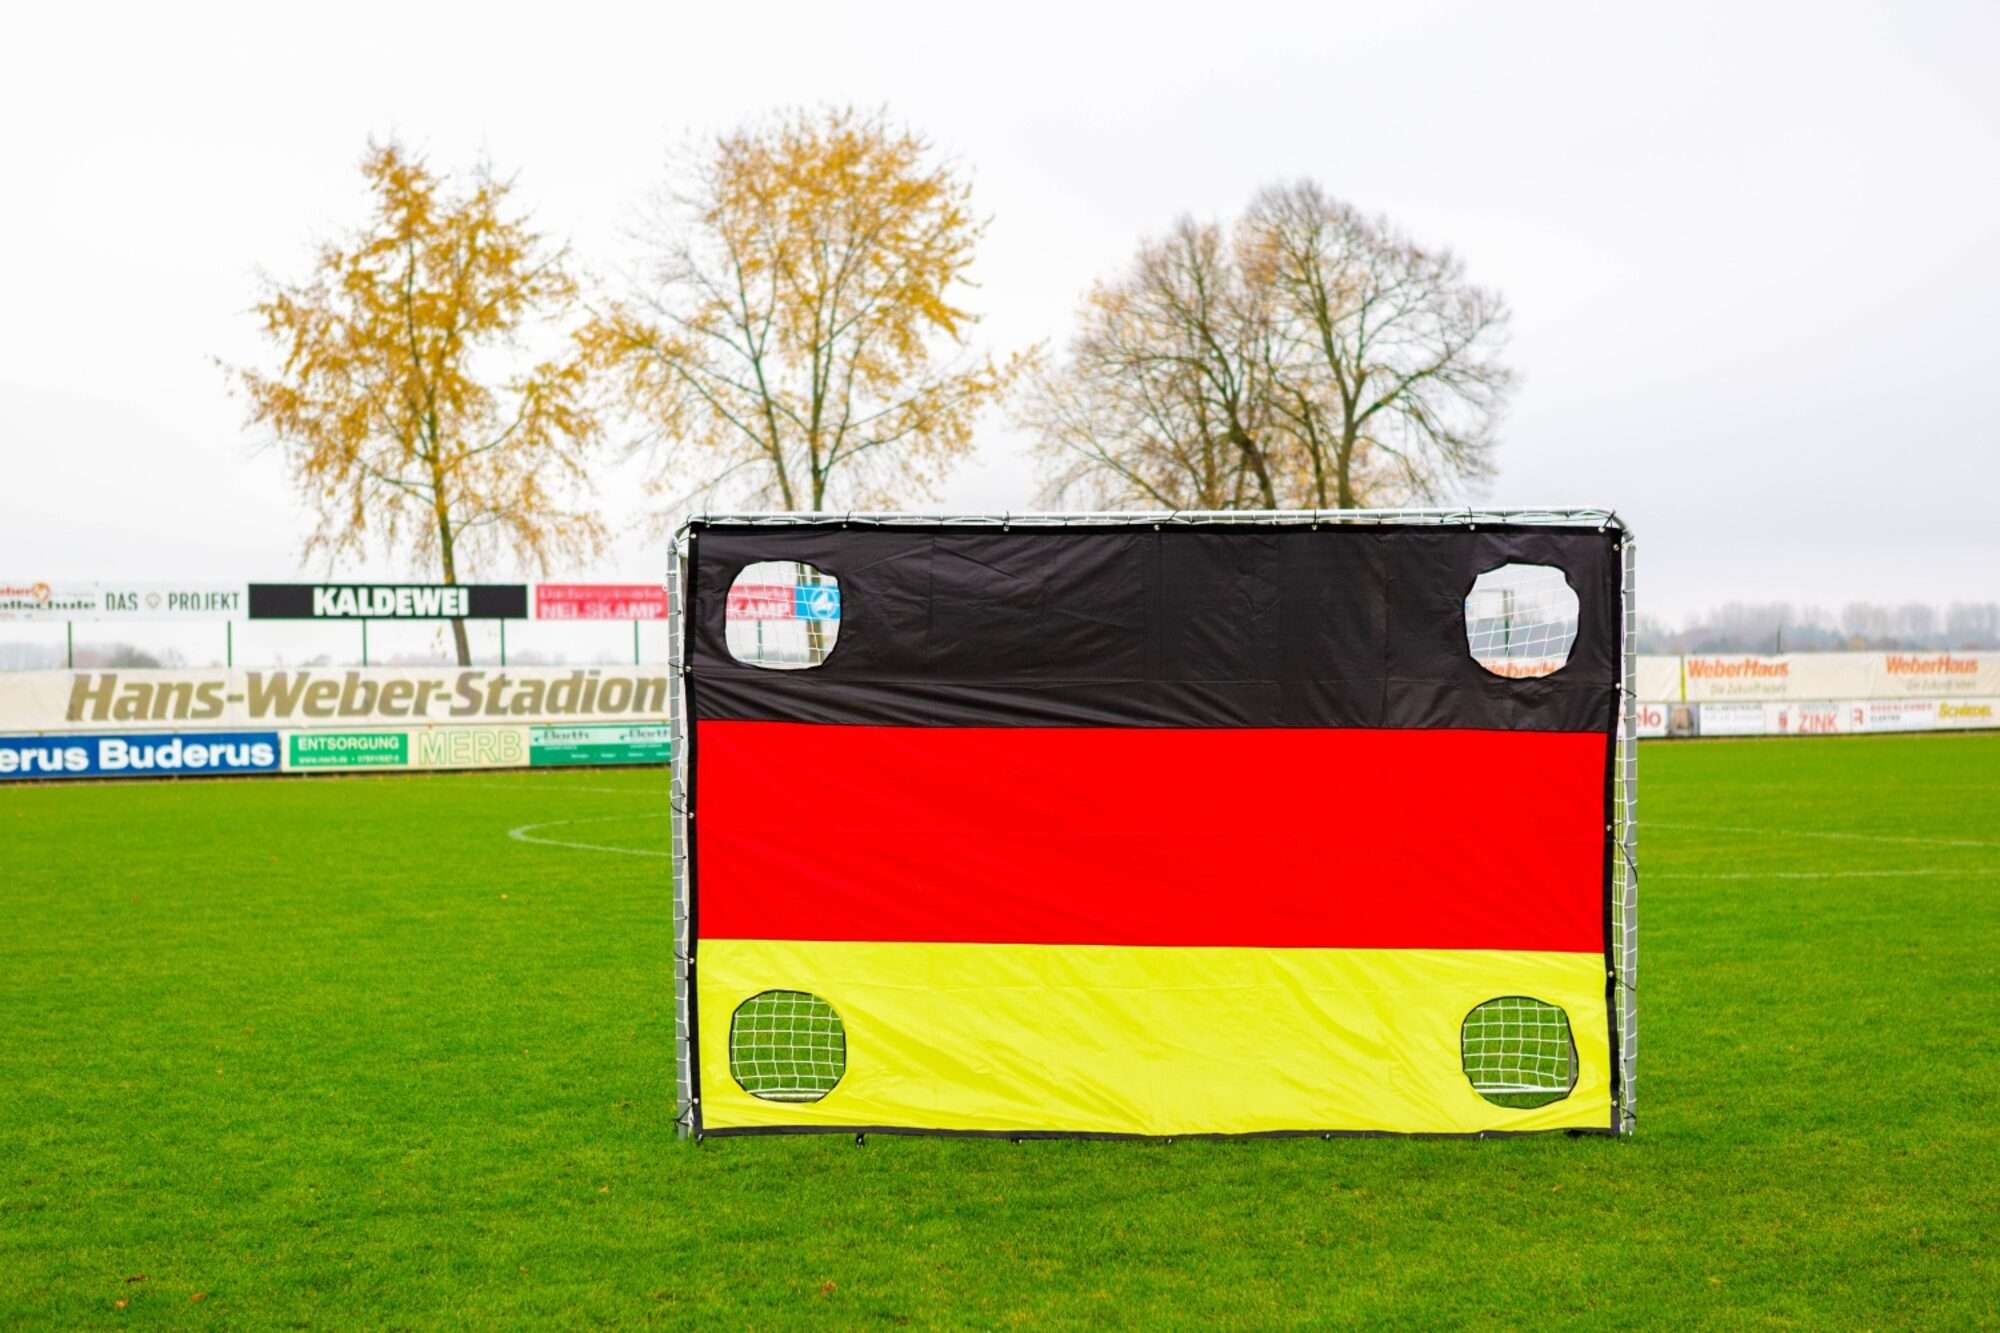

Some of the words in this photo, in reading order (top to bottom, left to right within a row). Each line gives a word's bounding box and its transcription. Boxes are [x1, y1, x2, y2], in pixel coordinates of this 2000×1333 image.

[105, 592, 139, 611] DAS
[168, 592, 240, 611] PROJEKT
[313, 587, 469, 616] KALDEWEI
[541, 602, 663, 619] NELSKAMP
[1687, 658, 1790, 679] WeberHaus
[1886, 655, 1979, 674] WeberHaus
[65, 671, 669, 722] Hans-Weber-Stadion
[1799, 712, 1838, 733] ZINK
[298, 736, 400, 750] ENTSORGUNG
[417, 729, 524, 766] MERB
[98, 738, 276, 770] Buderus
